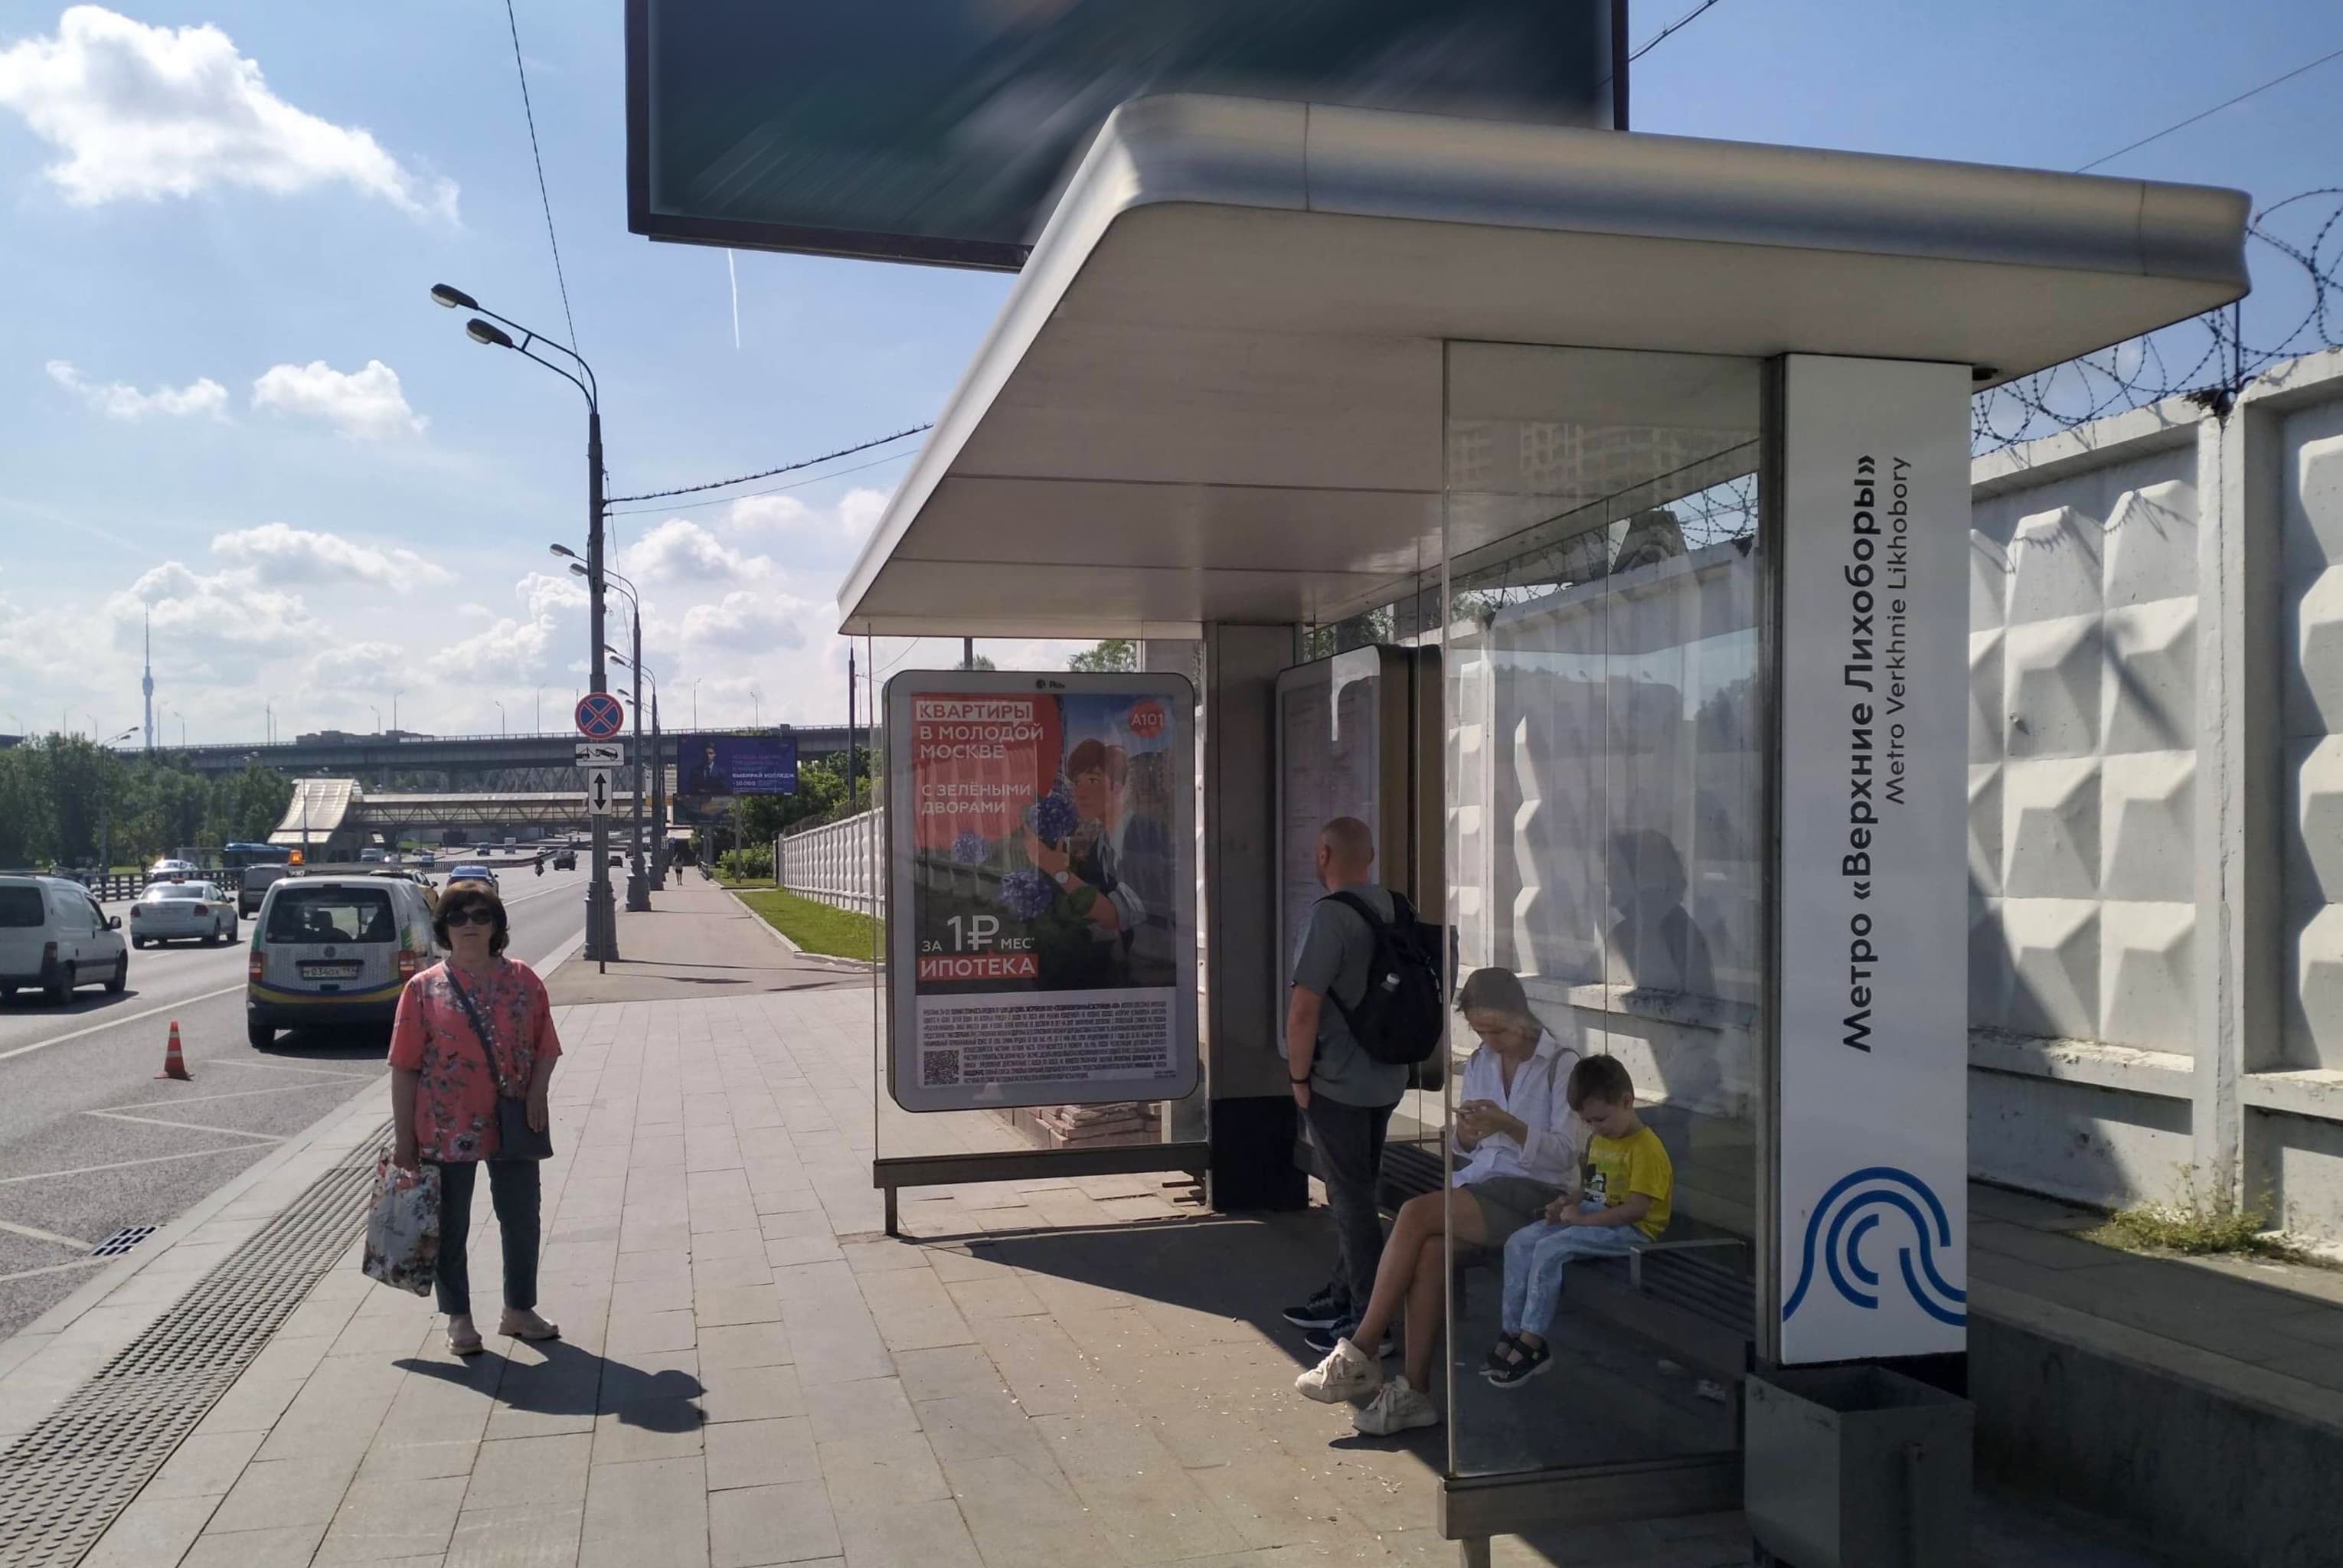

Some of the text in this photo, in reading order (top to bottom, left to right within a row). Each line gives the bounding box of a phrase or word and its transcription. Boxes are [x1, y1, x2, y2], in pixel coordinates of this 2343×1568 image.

[1885, 456, 1912, 805] Metro Verkhnie Likhobory
[920, 704, 1030, 719] КВАРТИРЫ
[920, 722, 1044, 742] В МОЛОДОЙ
[920, 744, 1005, 759] МОСКВЕ
[1842, 455, 1881, 1054] Метро «Верхние Лихоборы»
[922, 782, 1031, 797] С ЗЕЛЁНЫМИ
[921, 802, 1005, 815] ДВОРАМИ
[921, 940, 943, 952] ЗА
[920, 957, 1036, 978] ИПОТЕКА
